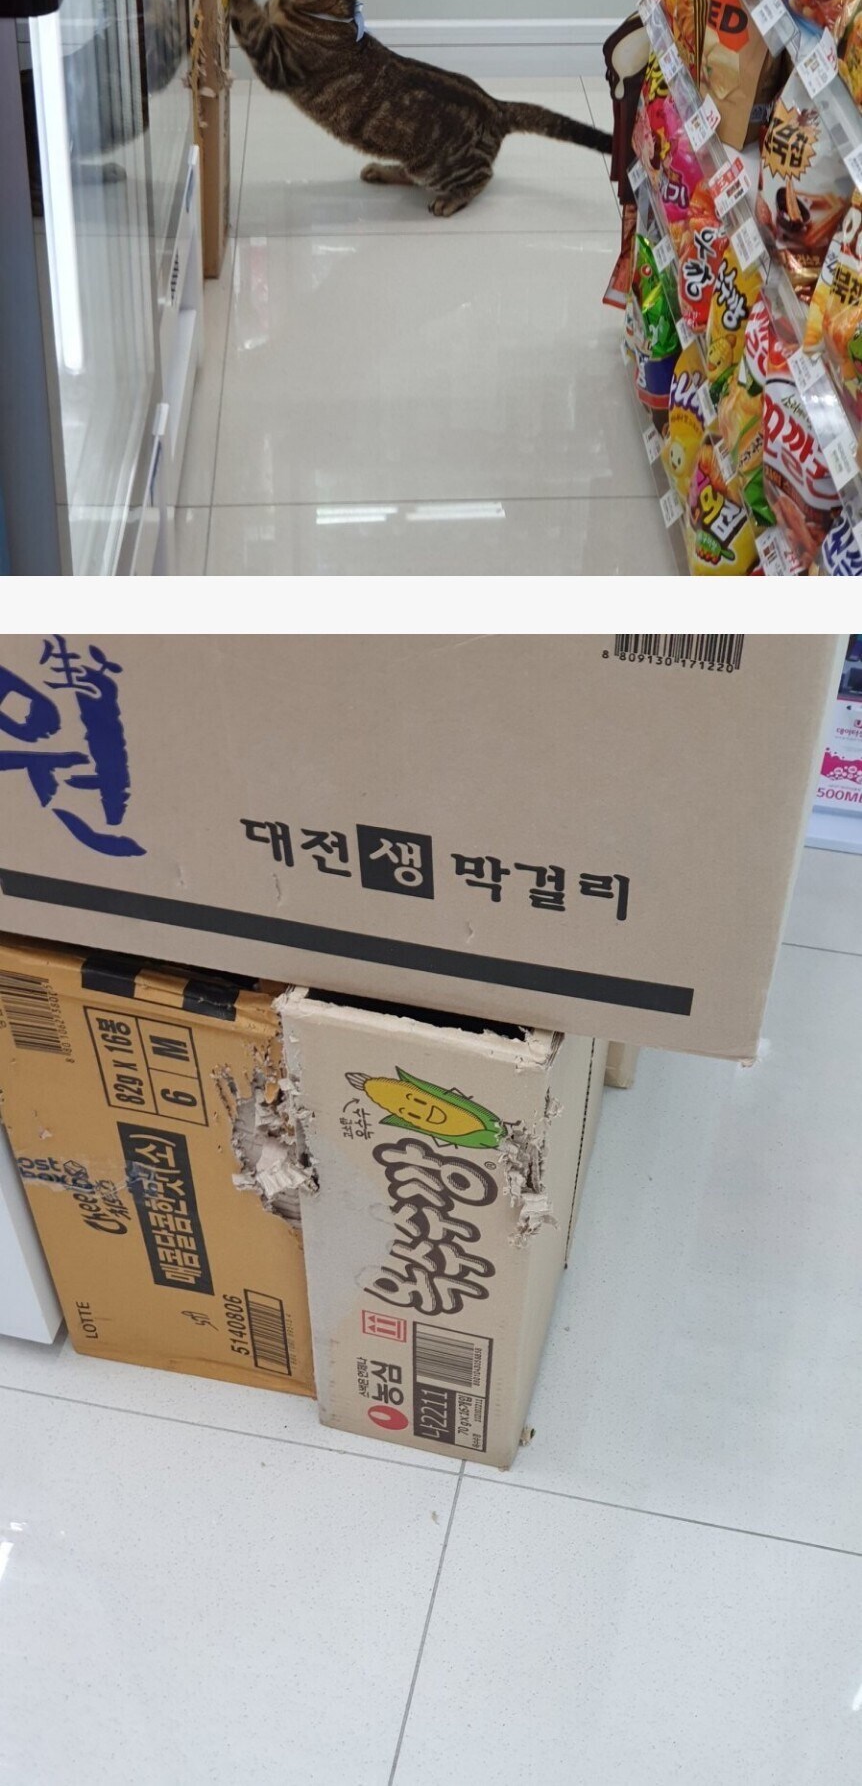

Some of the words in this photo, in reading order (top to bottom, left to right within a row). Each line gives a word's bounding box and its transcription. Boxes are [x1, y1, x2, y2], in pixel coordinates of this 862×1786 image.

[602, 649, 610, 660] 8
[618, 652, 673, 667] 809130
[680, 658, 734, 674] 171220
[239, 817, 353, 878] 대전
[450, 852, 631, 922] 막걸리
[96, 1017, 133, 1055] 16봉
[149, 1034, 191, 1063] M
[112, 1073, 146, 1107] 82g
[352, 1107, 375, 1140] 옥수수
[358, 1137, 499, 1316] 옥수수깡
[76, 1300, 99, 1340] LOTTE
[222, 1293, 251, 1356] 5140806
[369, 1359, 405, 1406] 농심
